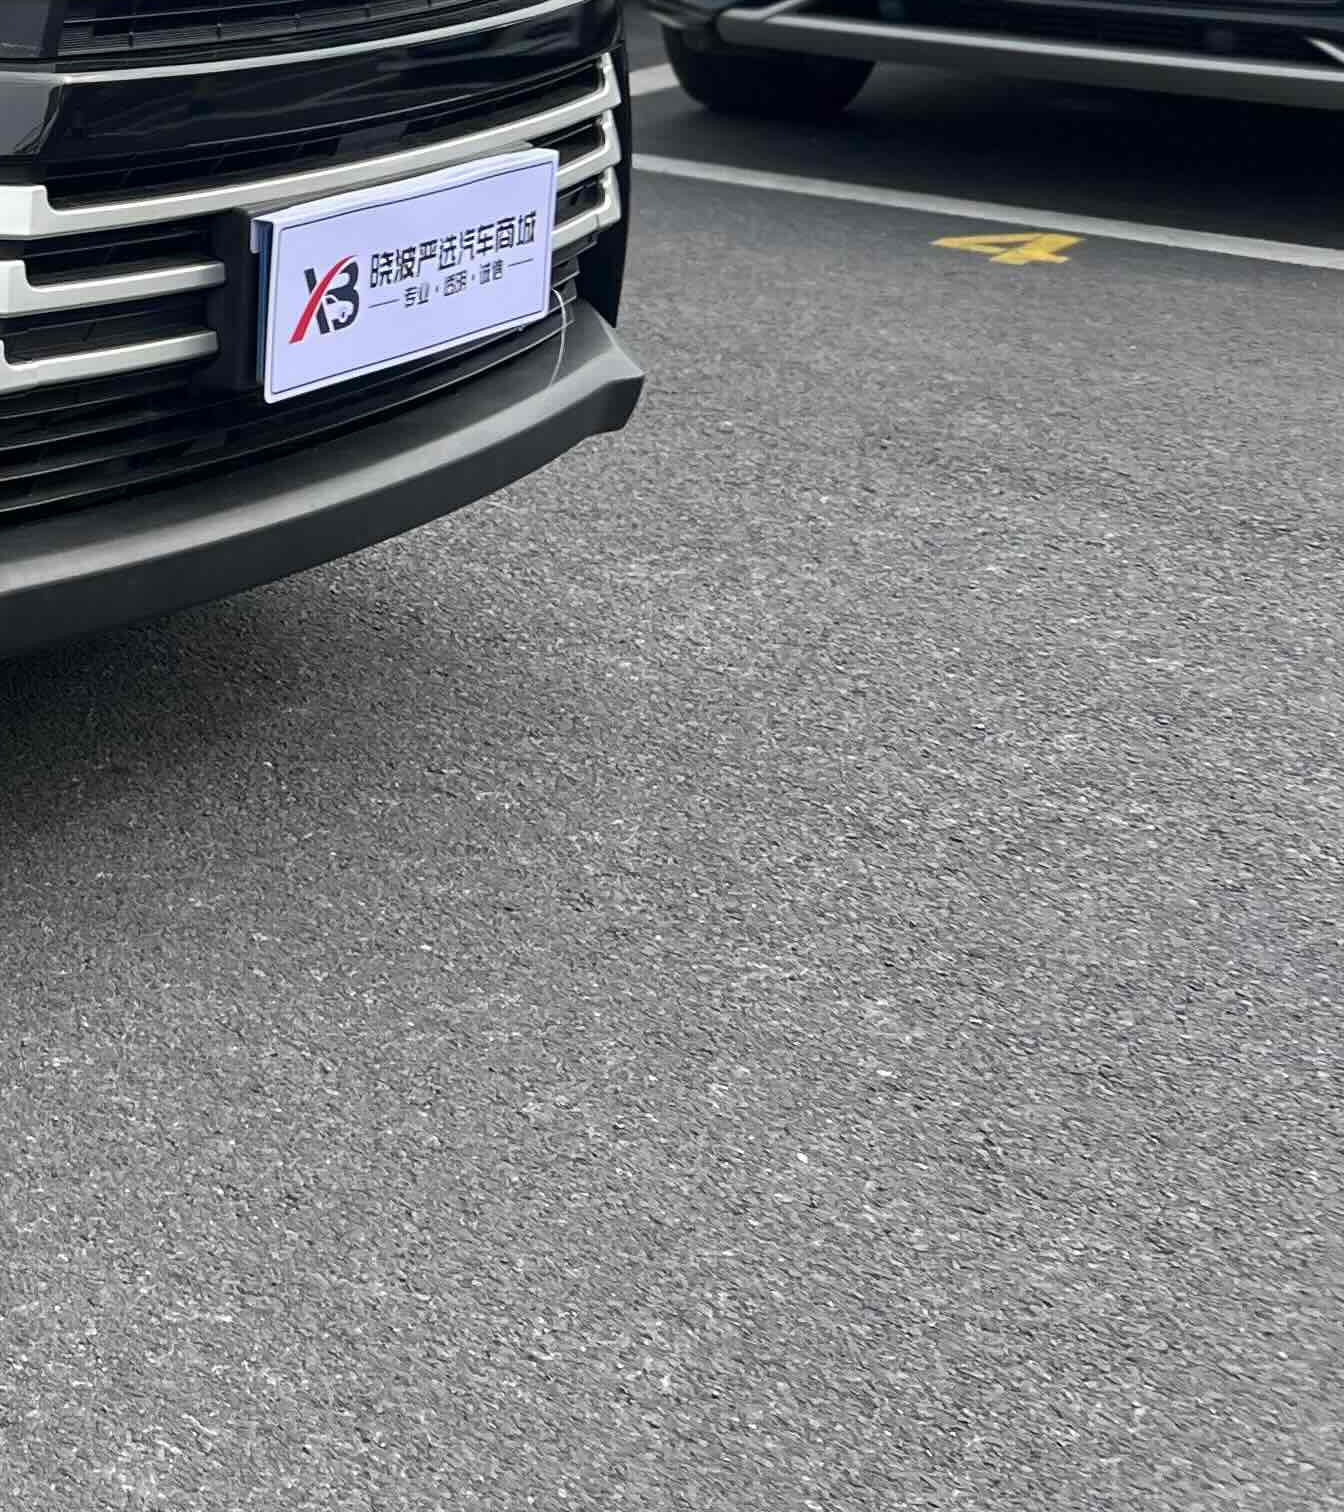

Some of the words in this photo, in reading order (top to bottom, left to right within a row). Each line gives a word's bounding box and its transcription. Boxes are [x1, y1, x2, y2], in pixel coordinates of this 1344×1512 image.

[369, 210, 537, 289] 晓波严选汽车商城
